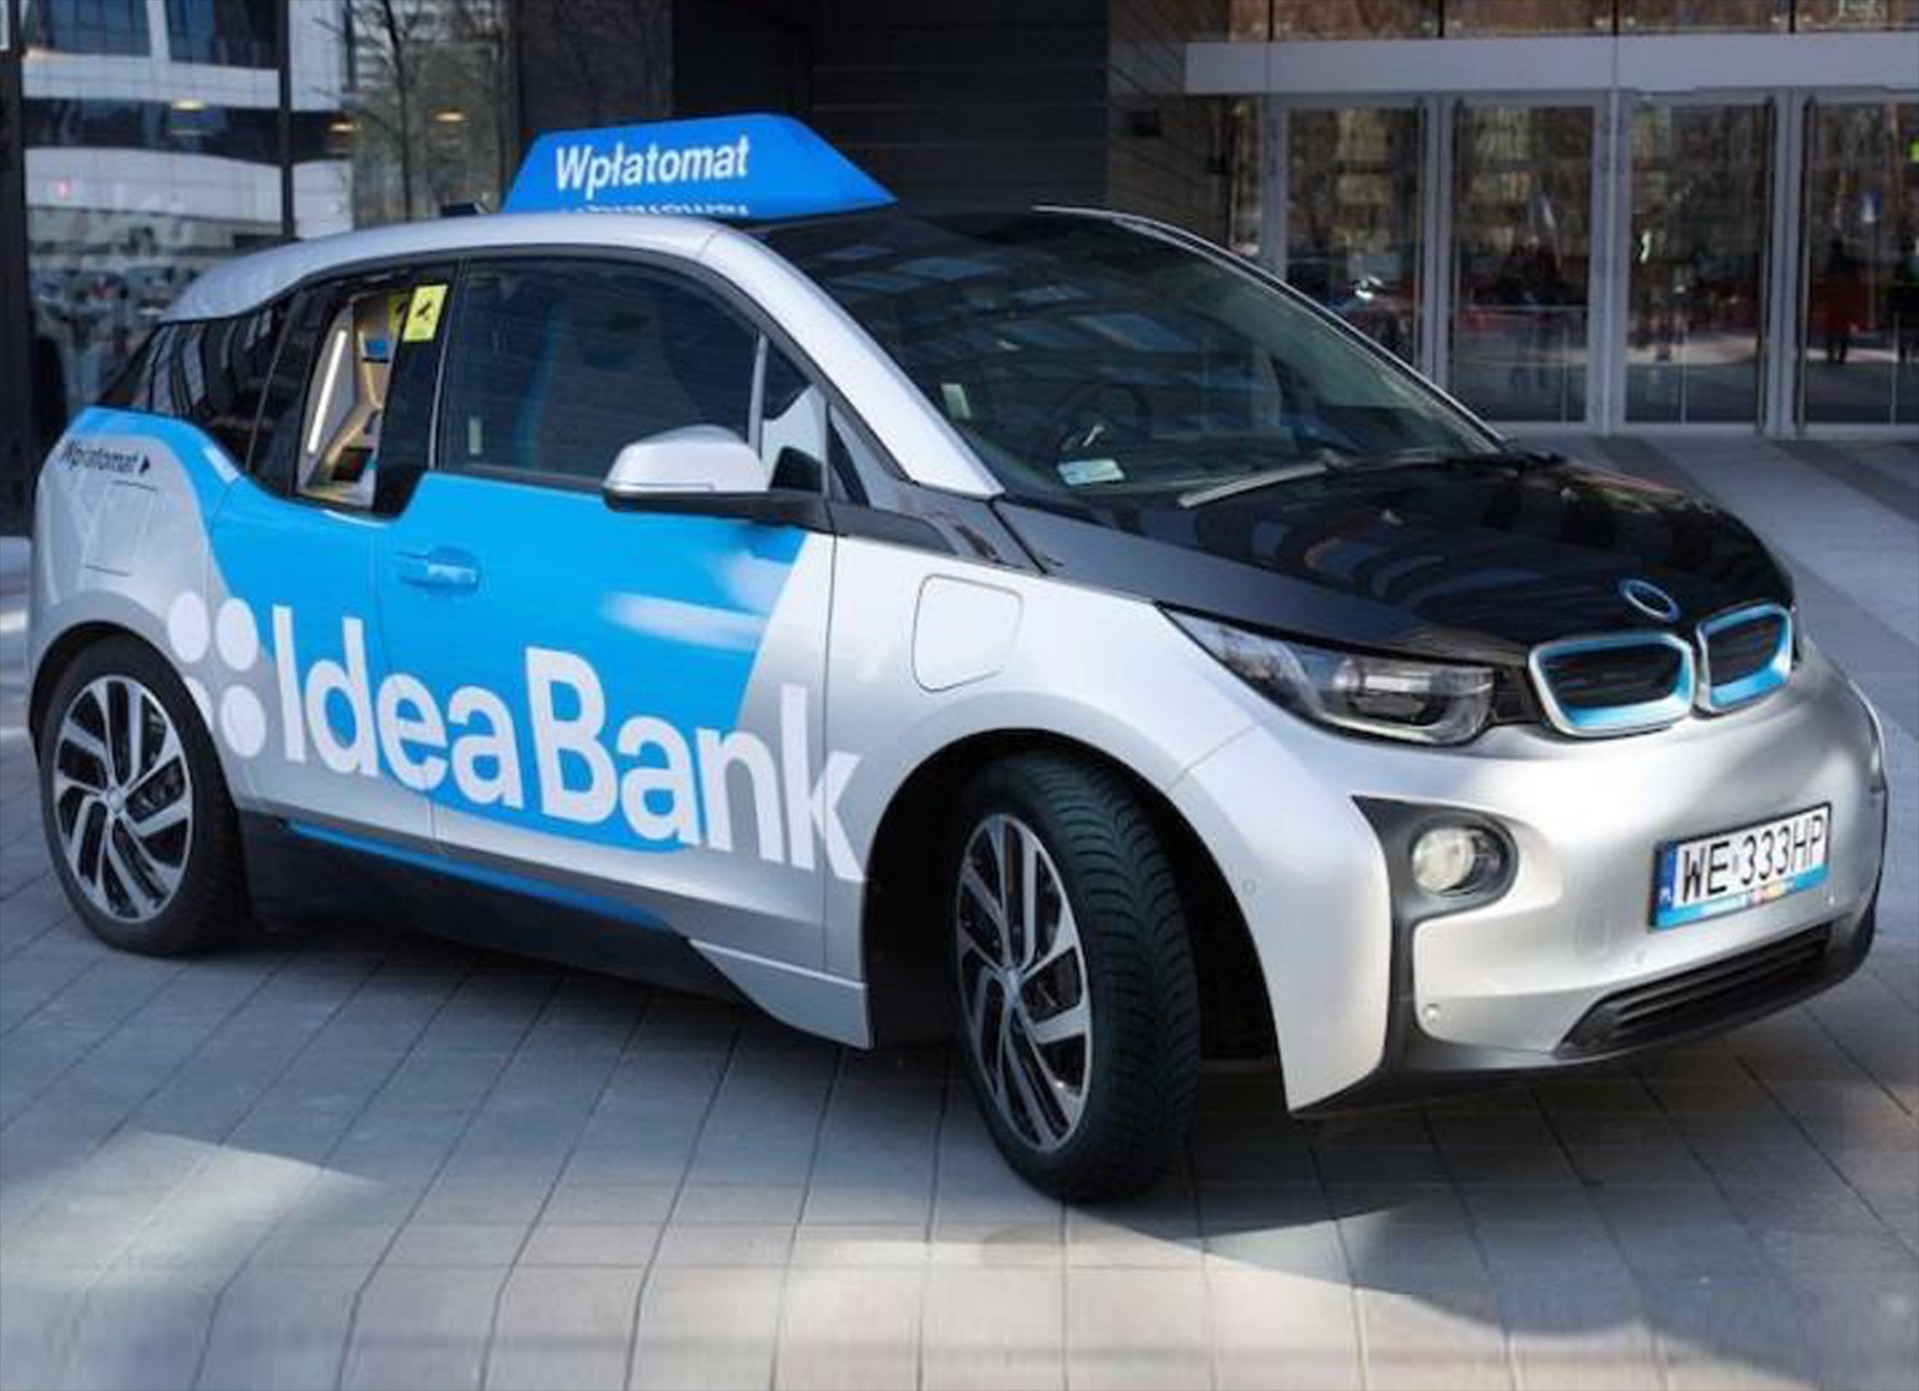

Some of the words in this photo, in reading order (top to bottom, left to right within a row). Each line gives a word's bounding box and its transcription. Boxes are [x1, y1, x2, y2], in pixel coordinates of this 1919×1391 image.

[555, 134, 750, 200] Wpłatomat
[271, 603, 524, 810] Idea
[524, 645, 867, 882] Bank
[1682, 839, 1731, 904] WE
[1740, 814, 1825, 887] 333HP
